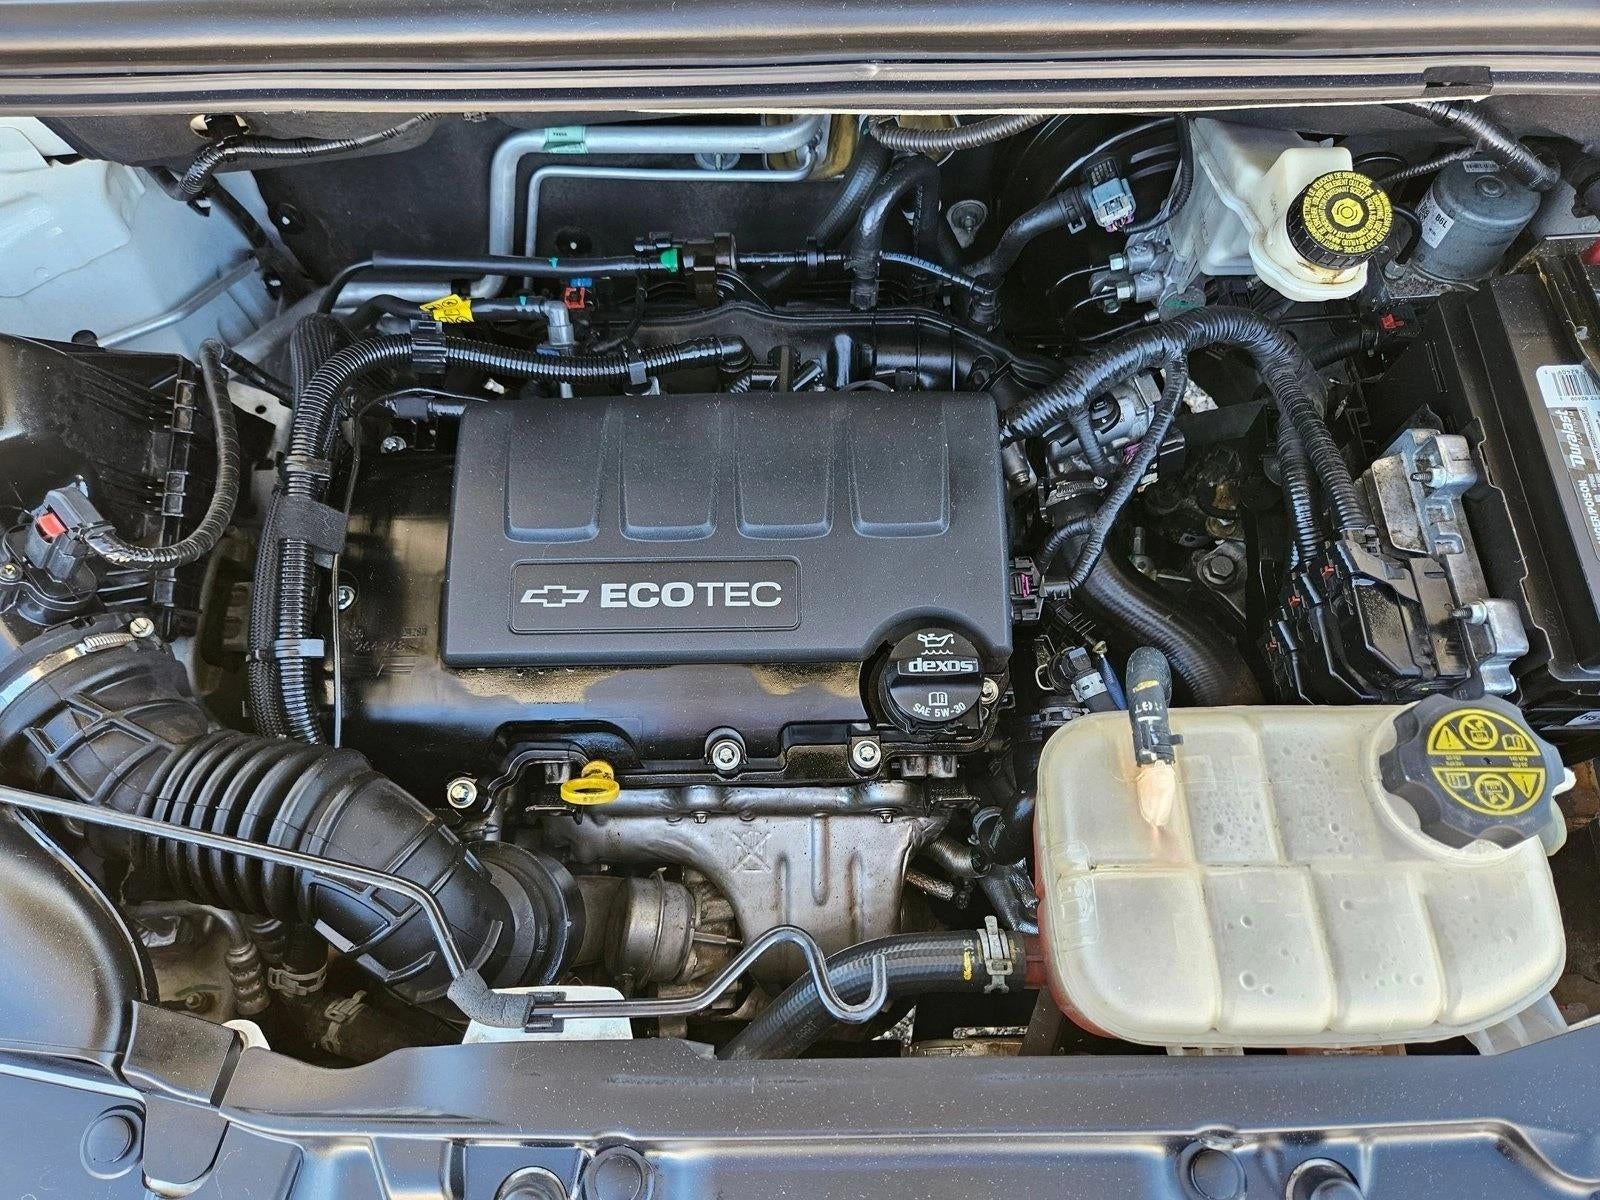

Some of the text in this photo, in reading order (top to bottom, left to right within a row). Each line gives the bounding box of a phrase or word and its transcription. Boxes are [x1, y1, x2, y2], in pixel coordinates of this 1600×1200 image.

[1435, 213, 1448, 229] B6L
[1555, 410, 1586, 468] Duralast
[600, 581, 782, 608] ECOTEC
[908, 657, 974, 672] dexos
[912, 702, 967, 718] SAE 5W-30
